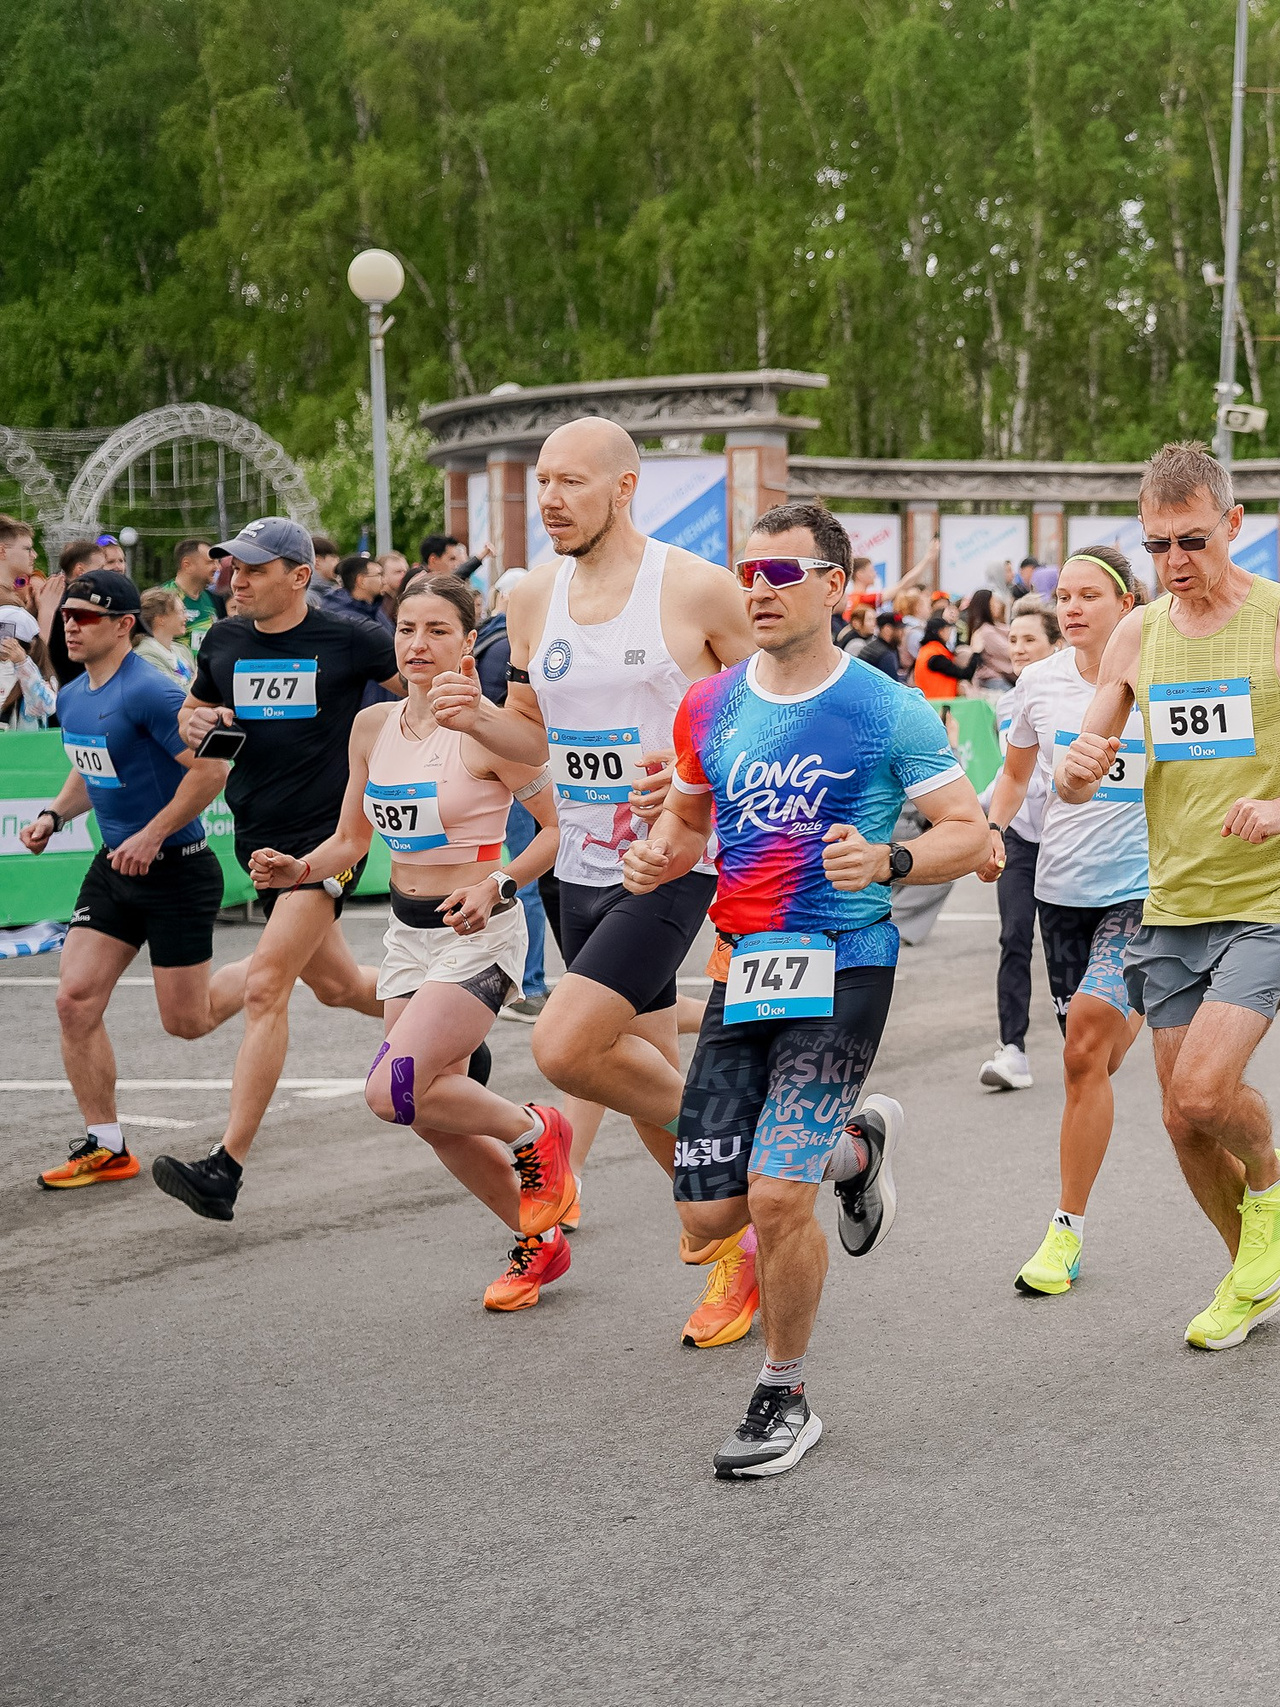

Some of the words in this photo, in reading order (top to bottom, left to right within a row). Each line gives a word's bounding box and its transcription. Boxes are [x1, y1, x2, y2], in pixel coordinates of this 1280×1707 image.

[249, 677, 298, 700] 767
[1169, 703, 1227, 737] 581
[75, 750, 102, 771] 610
[566, 751, 623, 781] 890
[372, 803, 418, 831] 587
[787, 819, 823, 836] 2026
[742, 956, 810, 994] 747
